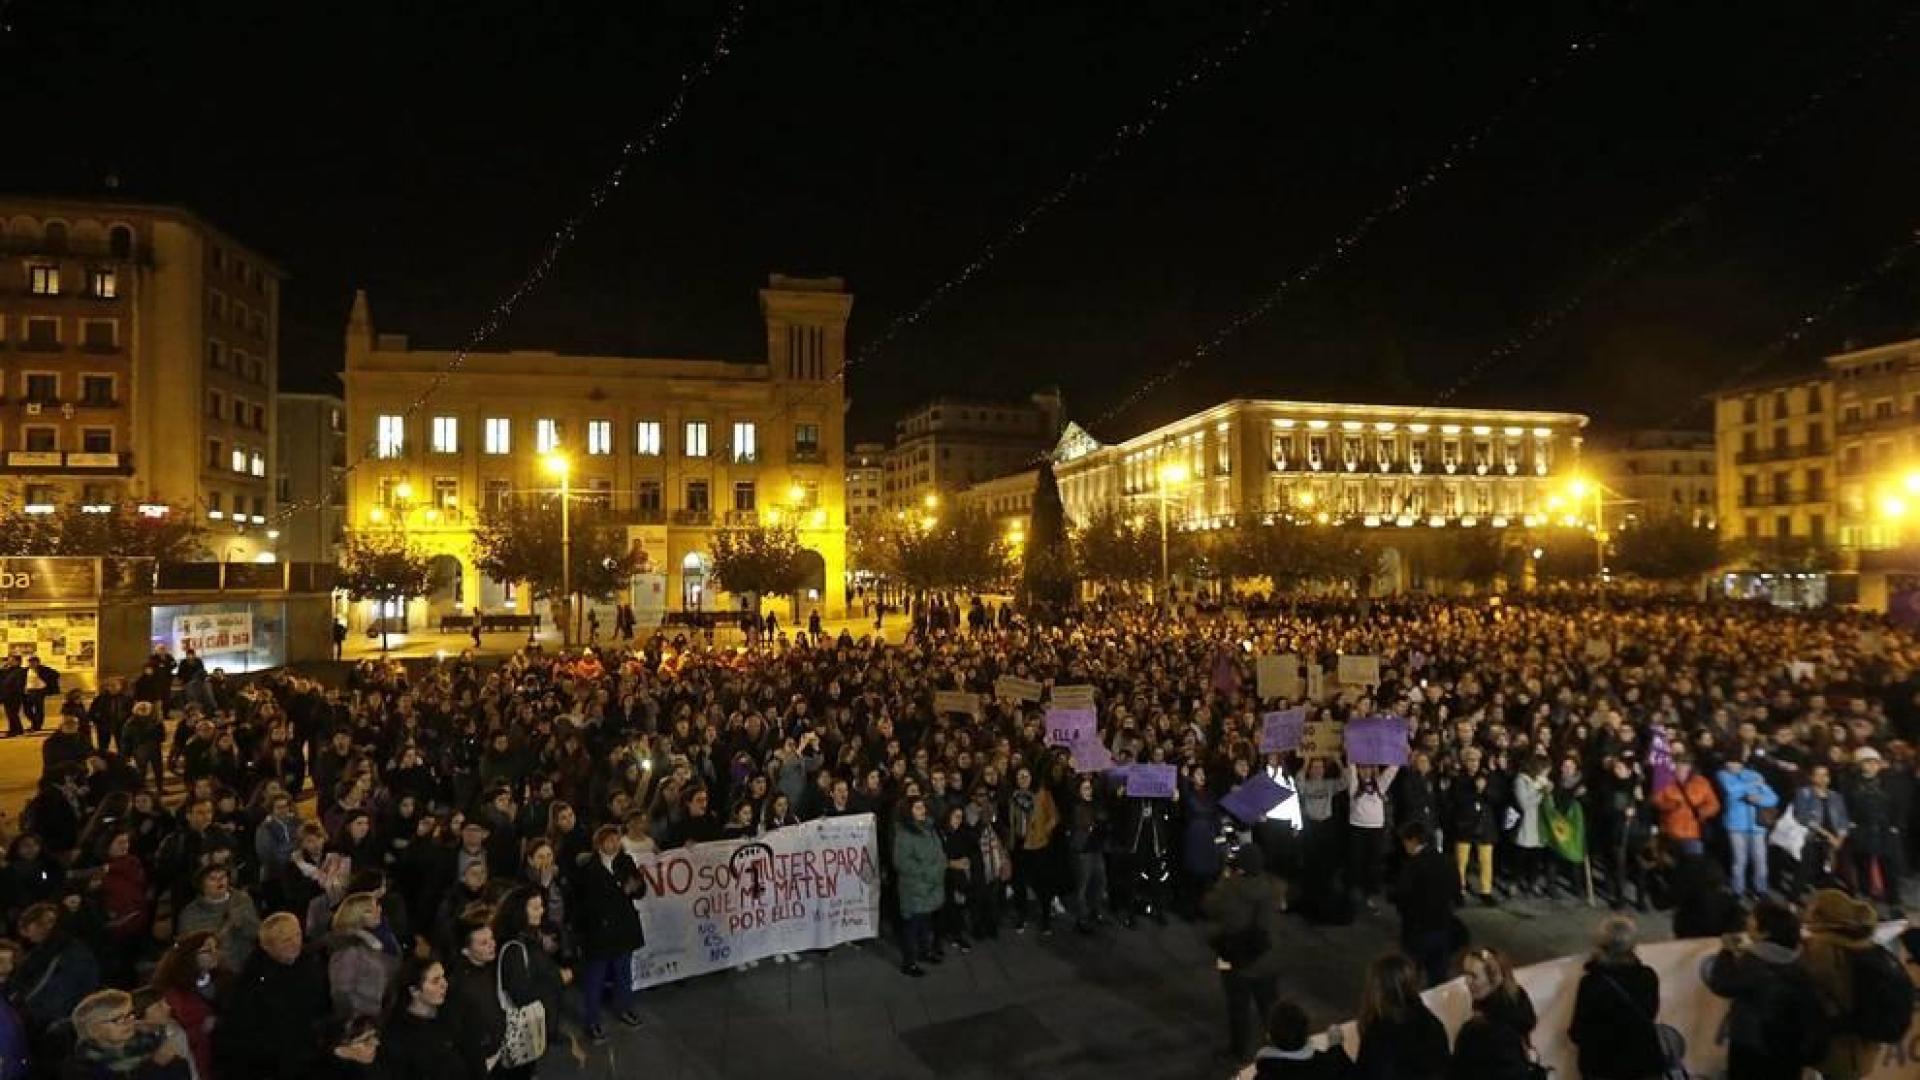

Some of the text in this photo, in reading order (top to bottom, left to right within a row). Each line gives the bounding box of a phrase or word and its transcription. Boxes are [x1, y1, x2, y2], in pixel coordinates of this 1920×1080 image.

[640, 858, 693, 896] NO
[698, 863, 746, 892] SOY
[822, 844, 878, 878] PARA
[693, 874, 837, 920] QUE ME MATEN
[698, 922, 716, 934] NO
[729, 909, 766, 935] POR
[772, 901, 806, 924] ELLO
[704, 935, 724, 947] ES
[710, 946, 732, 962] NO
